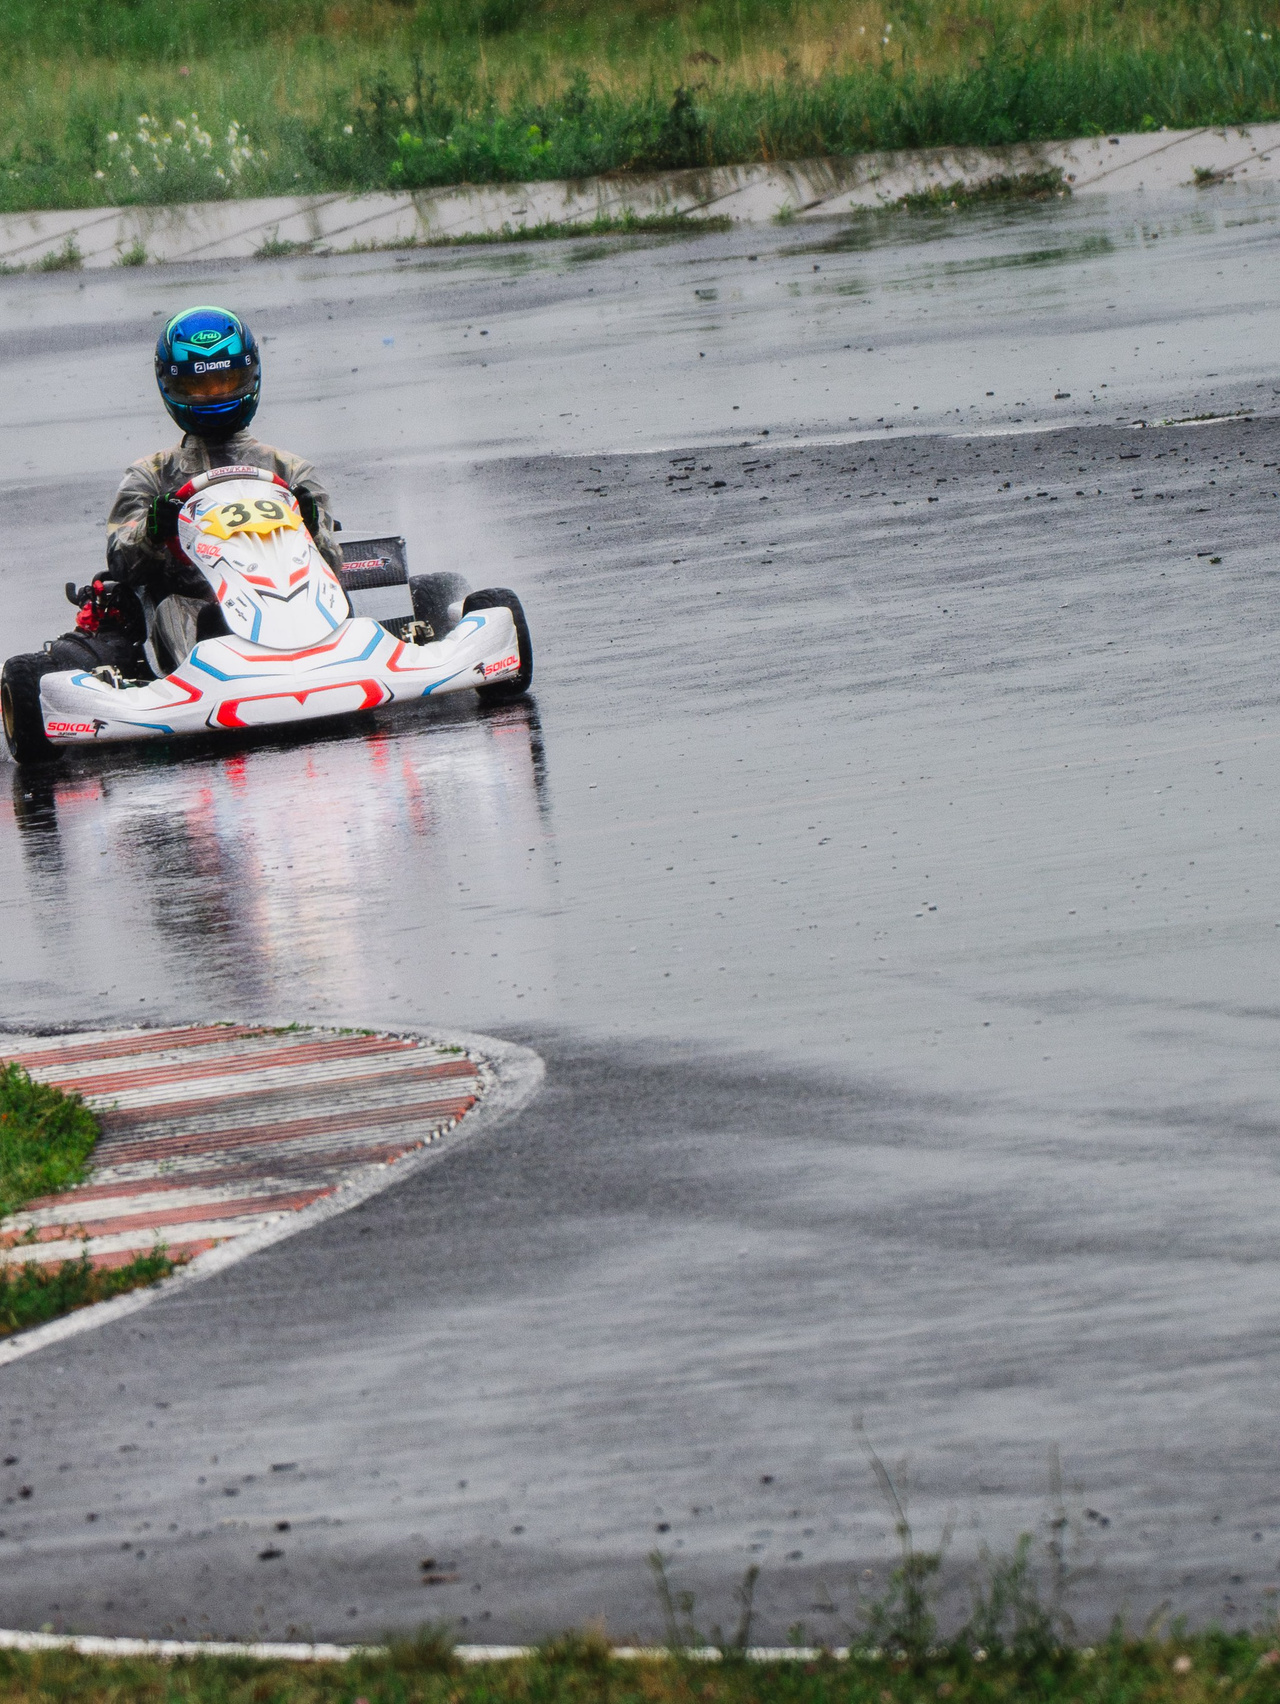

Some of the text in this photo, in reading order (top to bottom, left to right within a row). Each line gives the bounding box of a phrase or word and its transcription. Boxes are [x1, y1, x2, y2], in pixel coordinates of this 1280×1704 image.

[221, 500, 284, 527] 39
[196, 542, 221, 557] SOKOL
[341, 558, 382, 570] SOKOL
[485, 655, 518, 675] SOKOL
[47, 722, 95, 733] SOKOL
